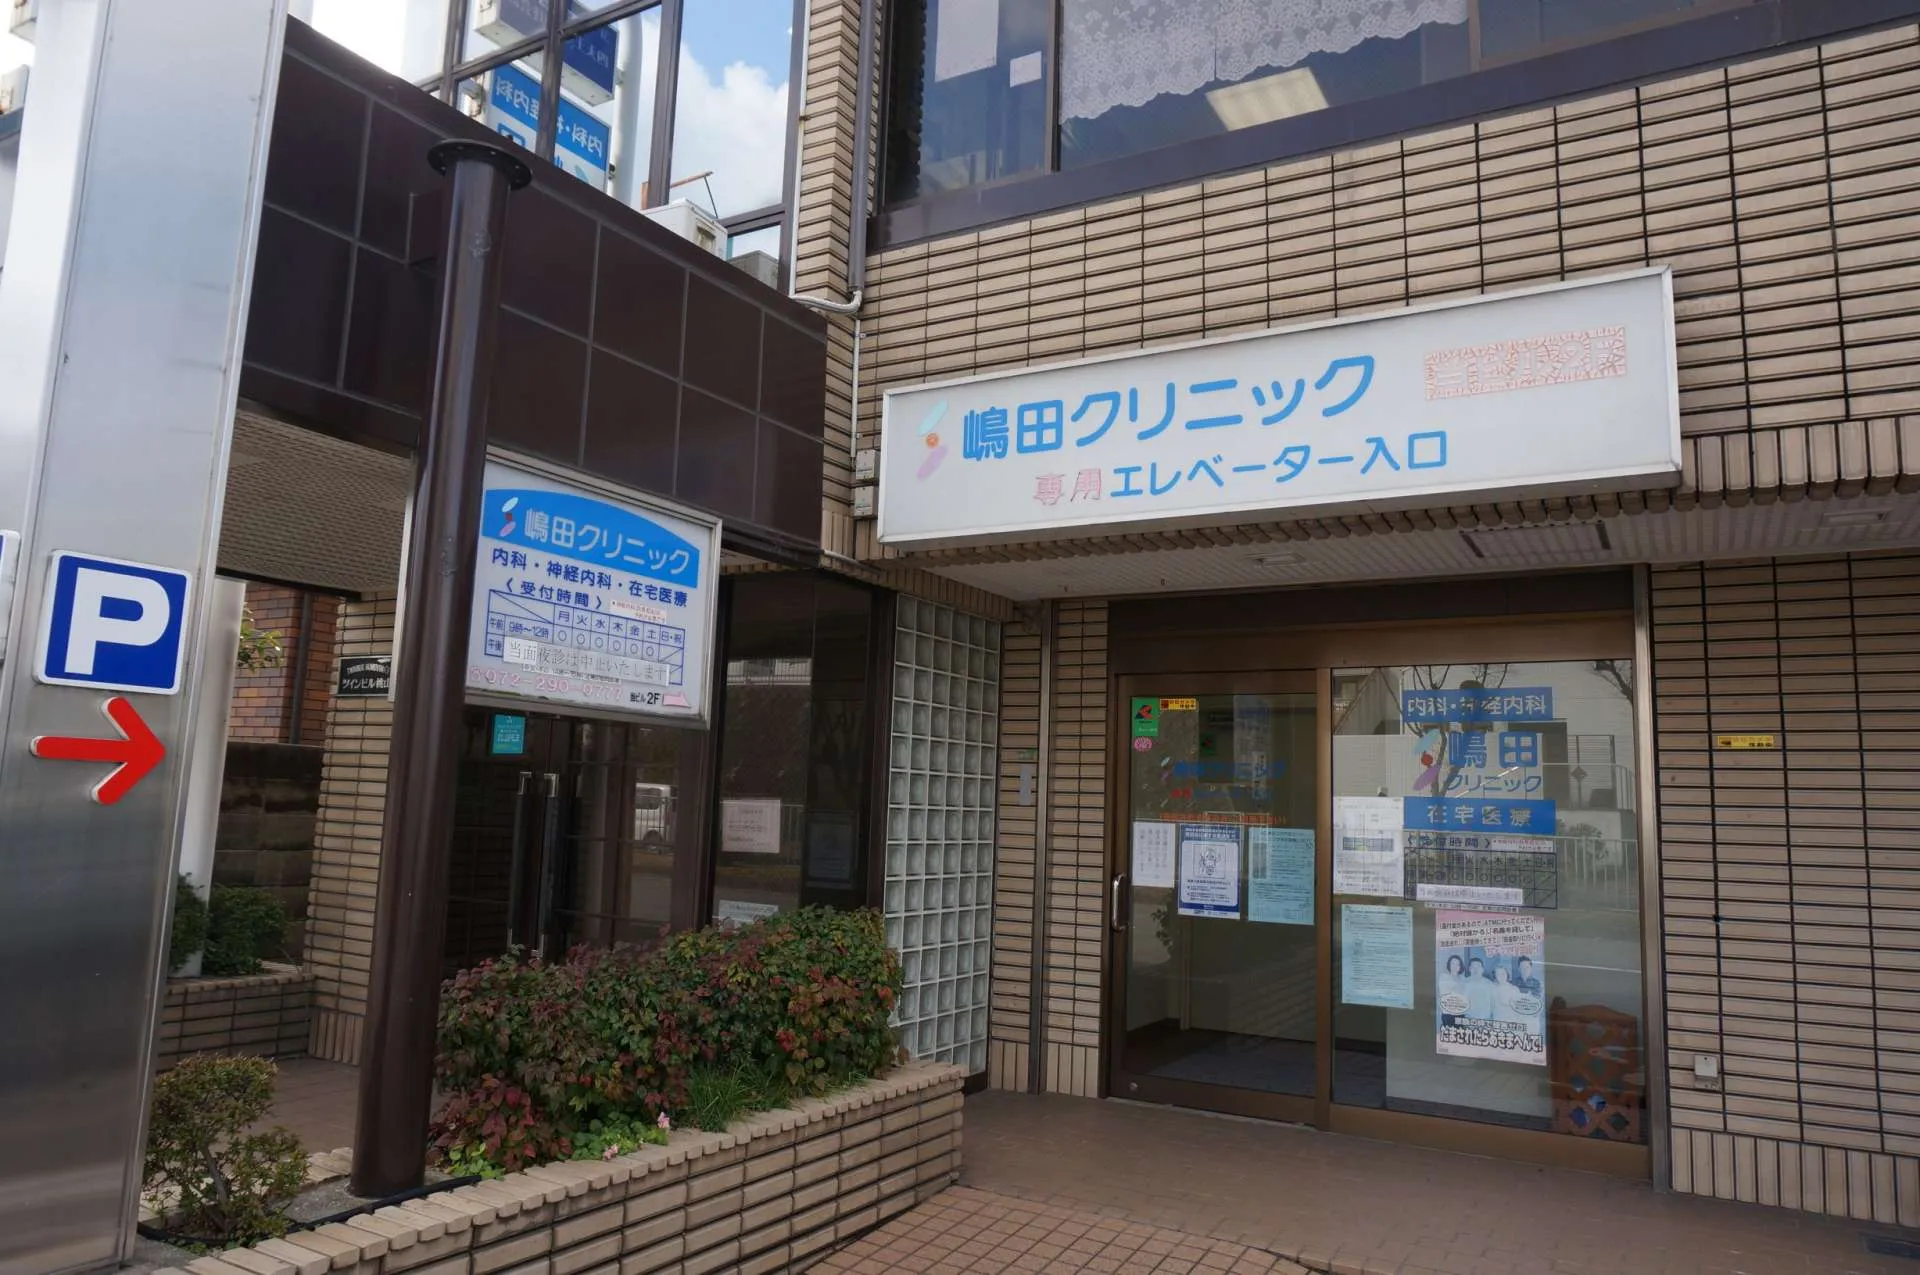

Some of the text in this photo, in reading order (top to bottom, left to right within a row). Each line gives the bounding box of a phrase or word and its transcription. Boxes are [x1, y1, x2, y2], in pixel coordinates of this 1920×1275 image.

[963, 355, 1375, 461] 嶋田クリニック
[525, 508, 690, 575] 嶋田クリニック
[492, 547, 688, 608] 内科・神経内科・在宅医療
[64, 567, 170, 675] P
[558, 611, 569, 622] 月
[576, 614, 588, 625] 火
[595, 617, 606, 629] 水
[613, 621, 623, 631] 木
[1408, 694, 1547, 719] 内科・神経内科
[1449, 730, 1539, 769] 嶋田
[1446, 774, 1542, 794] クリニック
[1428, 804, 1533, 827] 在宅医療
